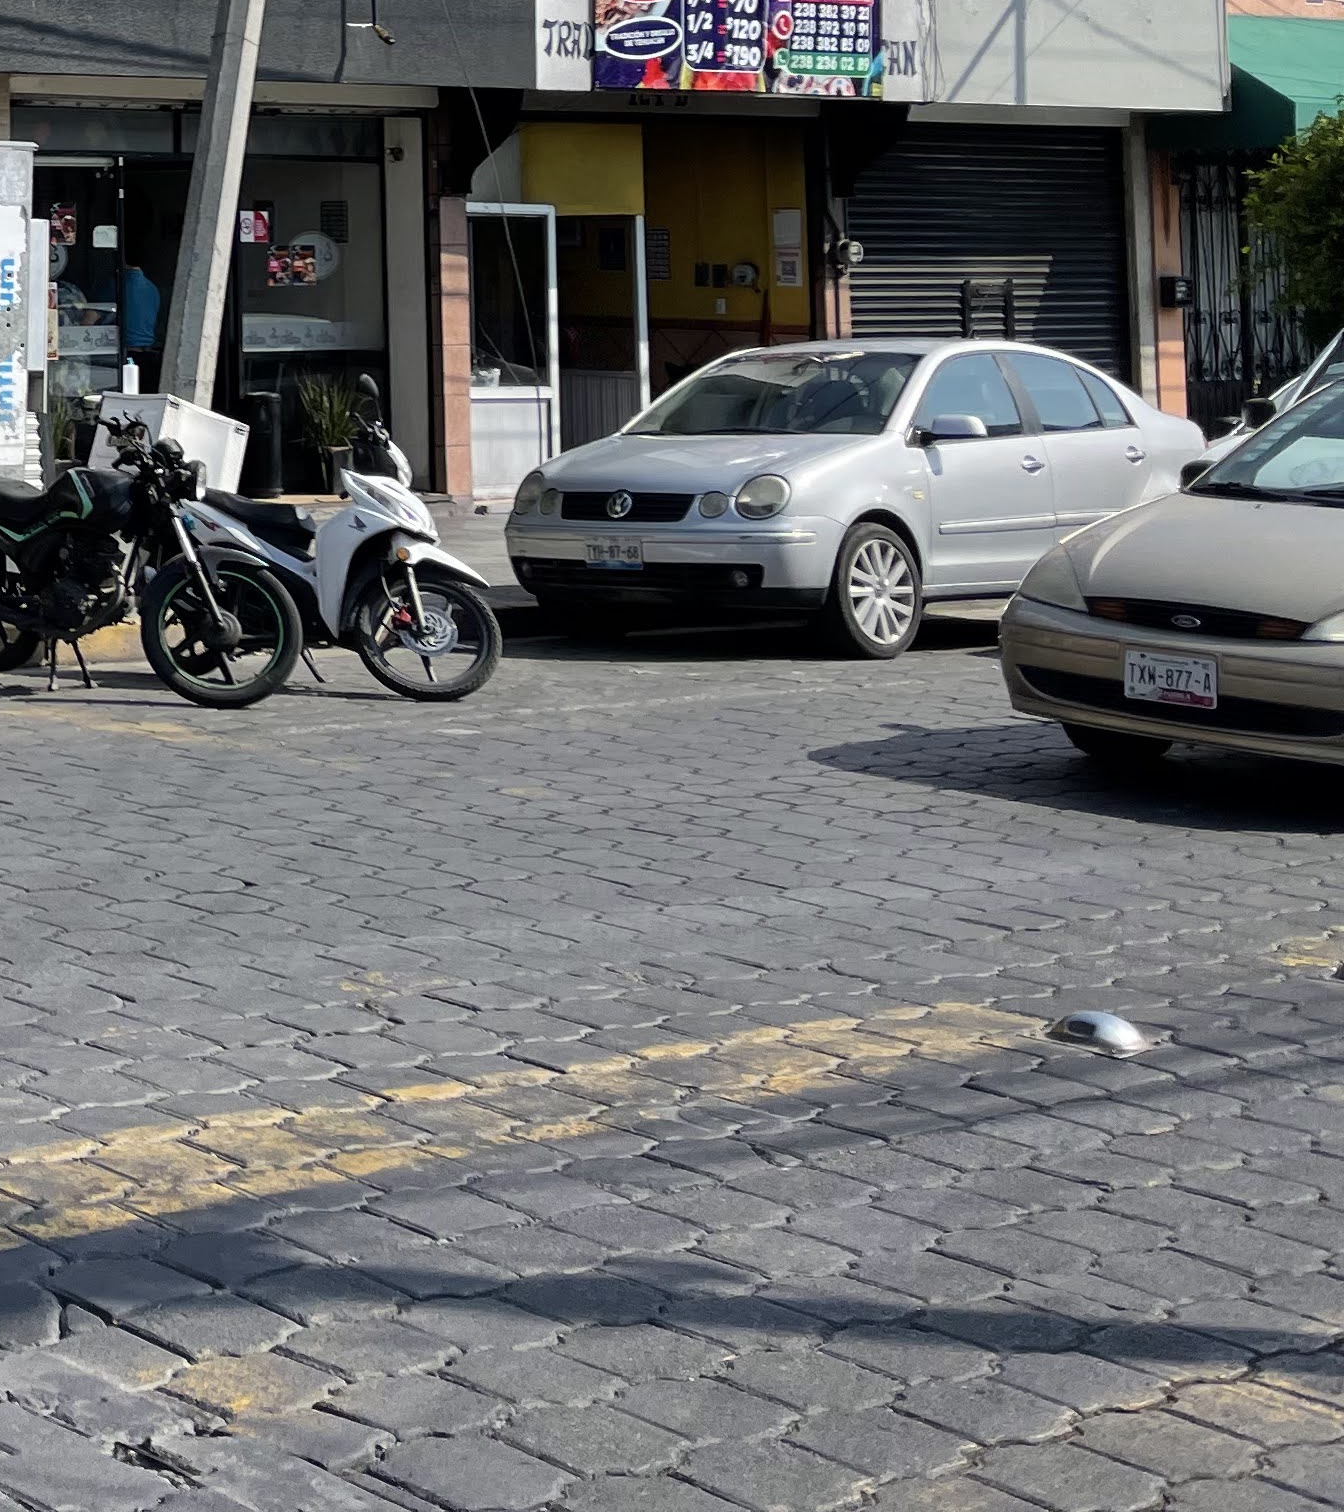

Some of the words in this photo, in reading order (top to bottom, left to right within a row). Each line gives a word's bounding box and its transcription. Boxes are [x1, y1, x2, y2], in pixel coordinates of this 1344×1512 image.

[794, 3, 817, 17] 238
[687, 11, 713, 33] 1/2
[726, 17, 761, 40] $120
[794, 19, 817, 34] 238
[791, 35, 814, 50] 238
[687, 41, 714, 64] 3/4
[724, 44, 761, 66] $190
[790, 55, 813, 69] 238
